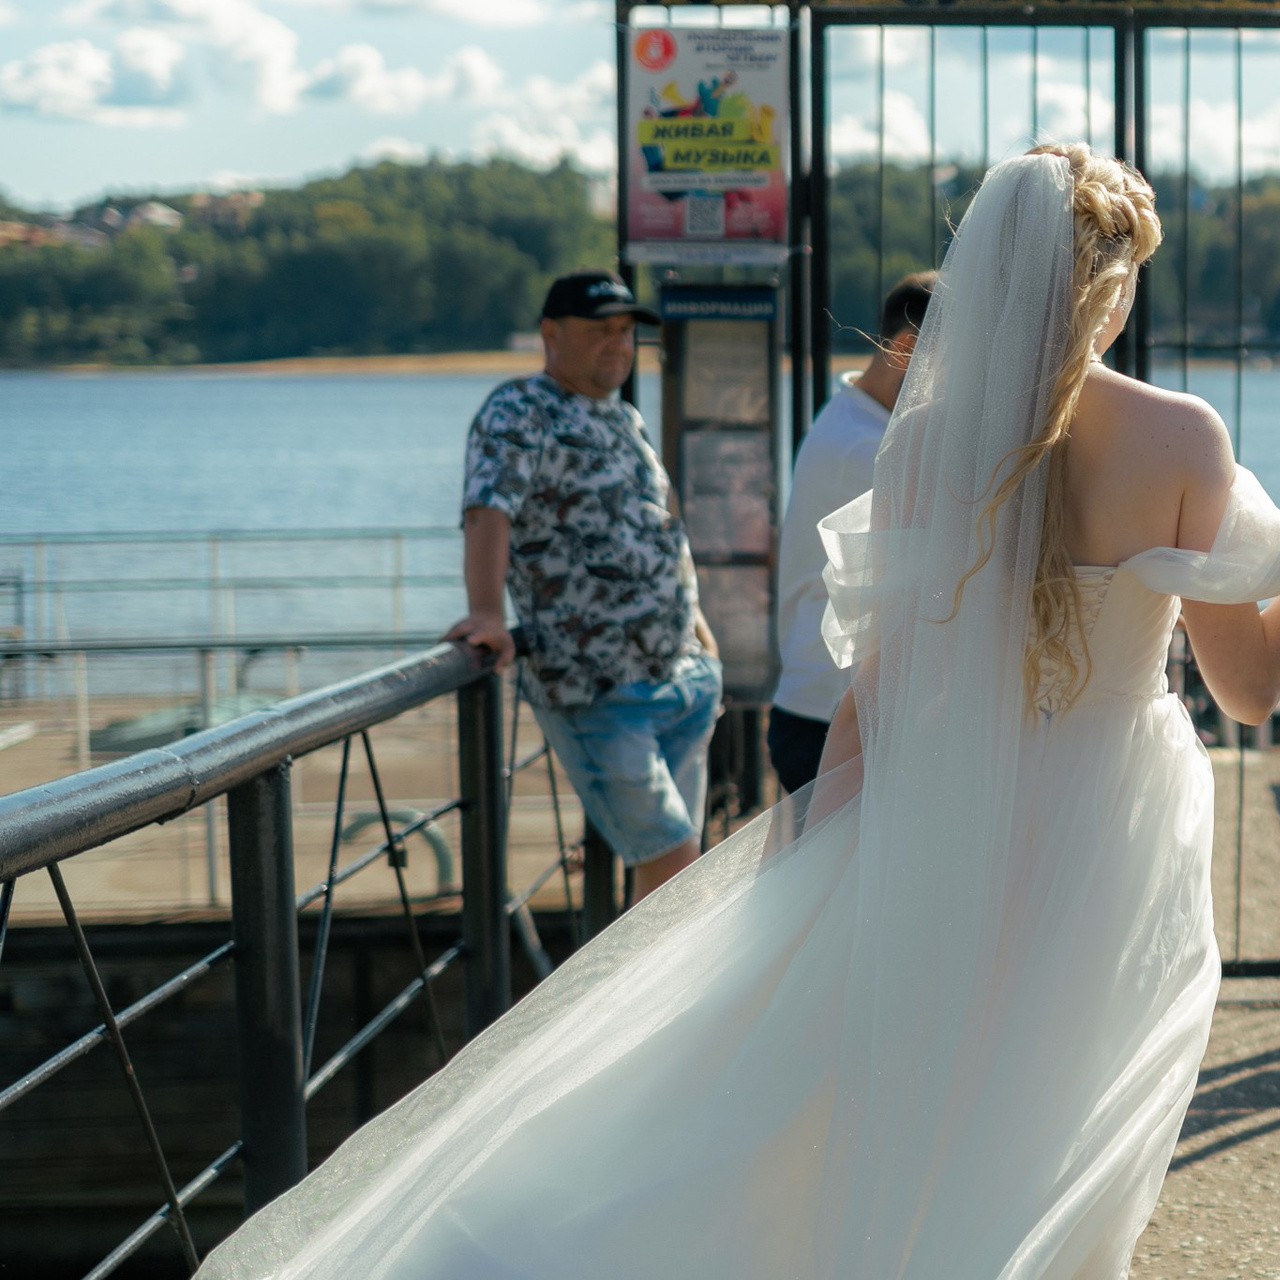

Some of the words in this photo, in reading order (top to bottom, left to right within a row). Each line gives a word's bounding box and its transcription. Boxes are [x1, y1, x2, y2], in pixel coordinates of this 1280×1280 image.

[653, 121, 735, 139] ЖИВАЯ
[673, 149, 772, 165] МУЗЫКА
[665, 301, 773, 315] ИНФОРМАЦИЯ
